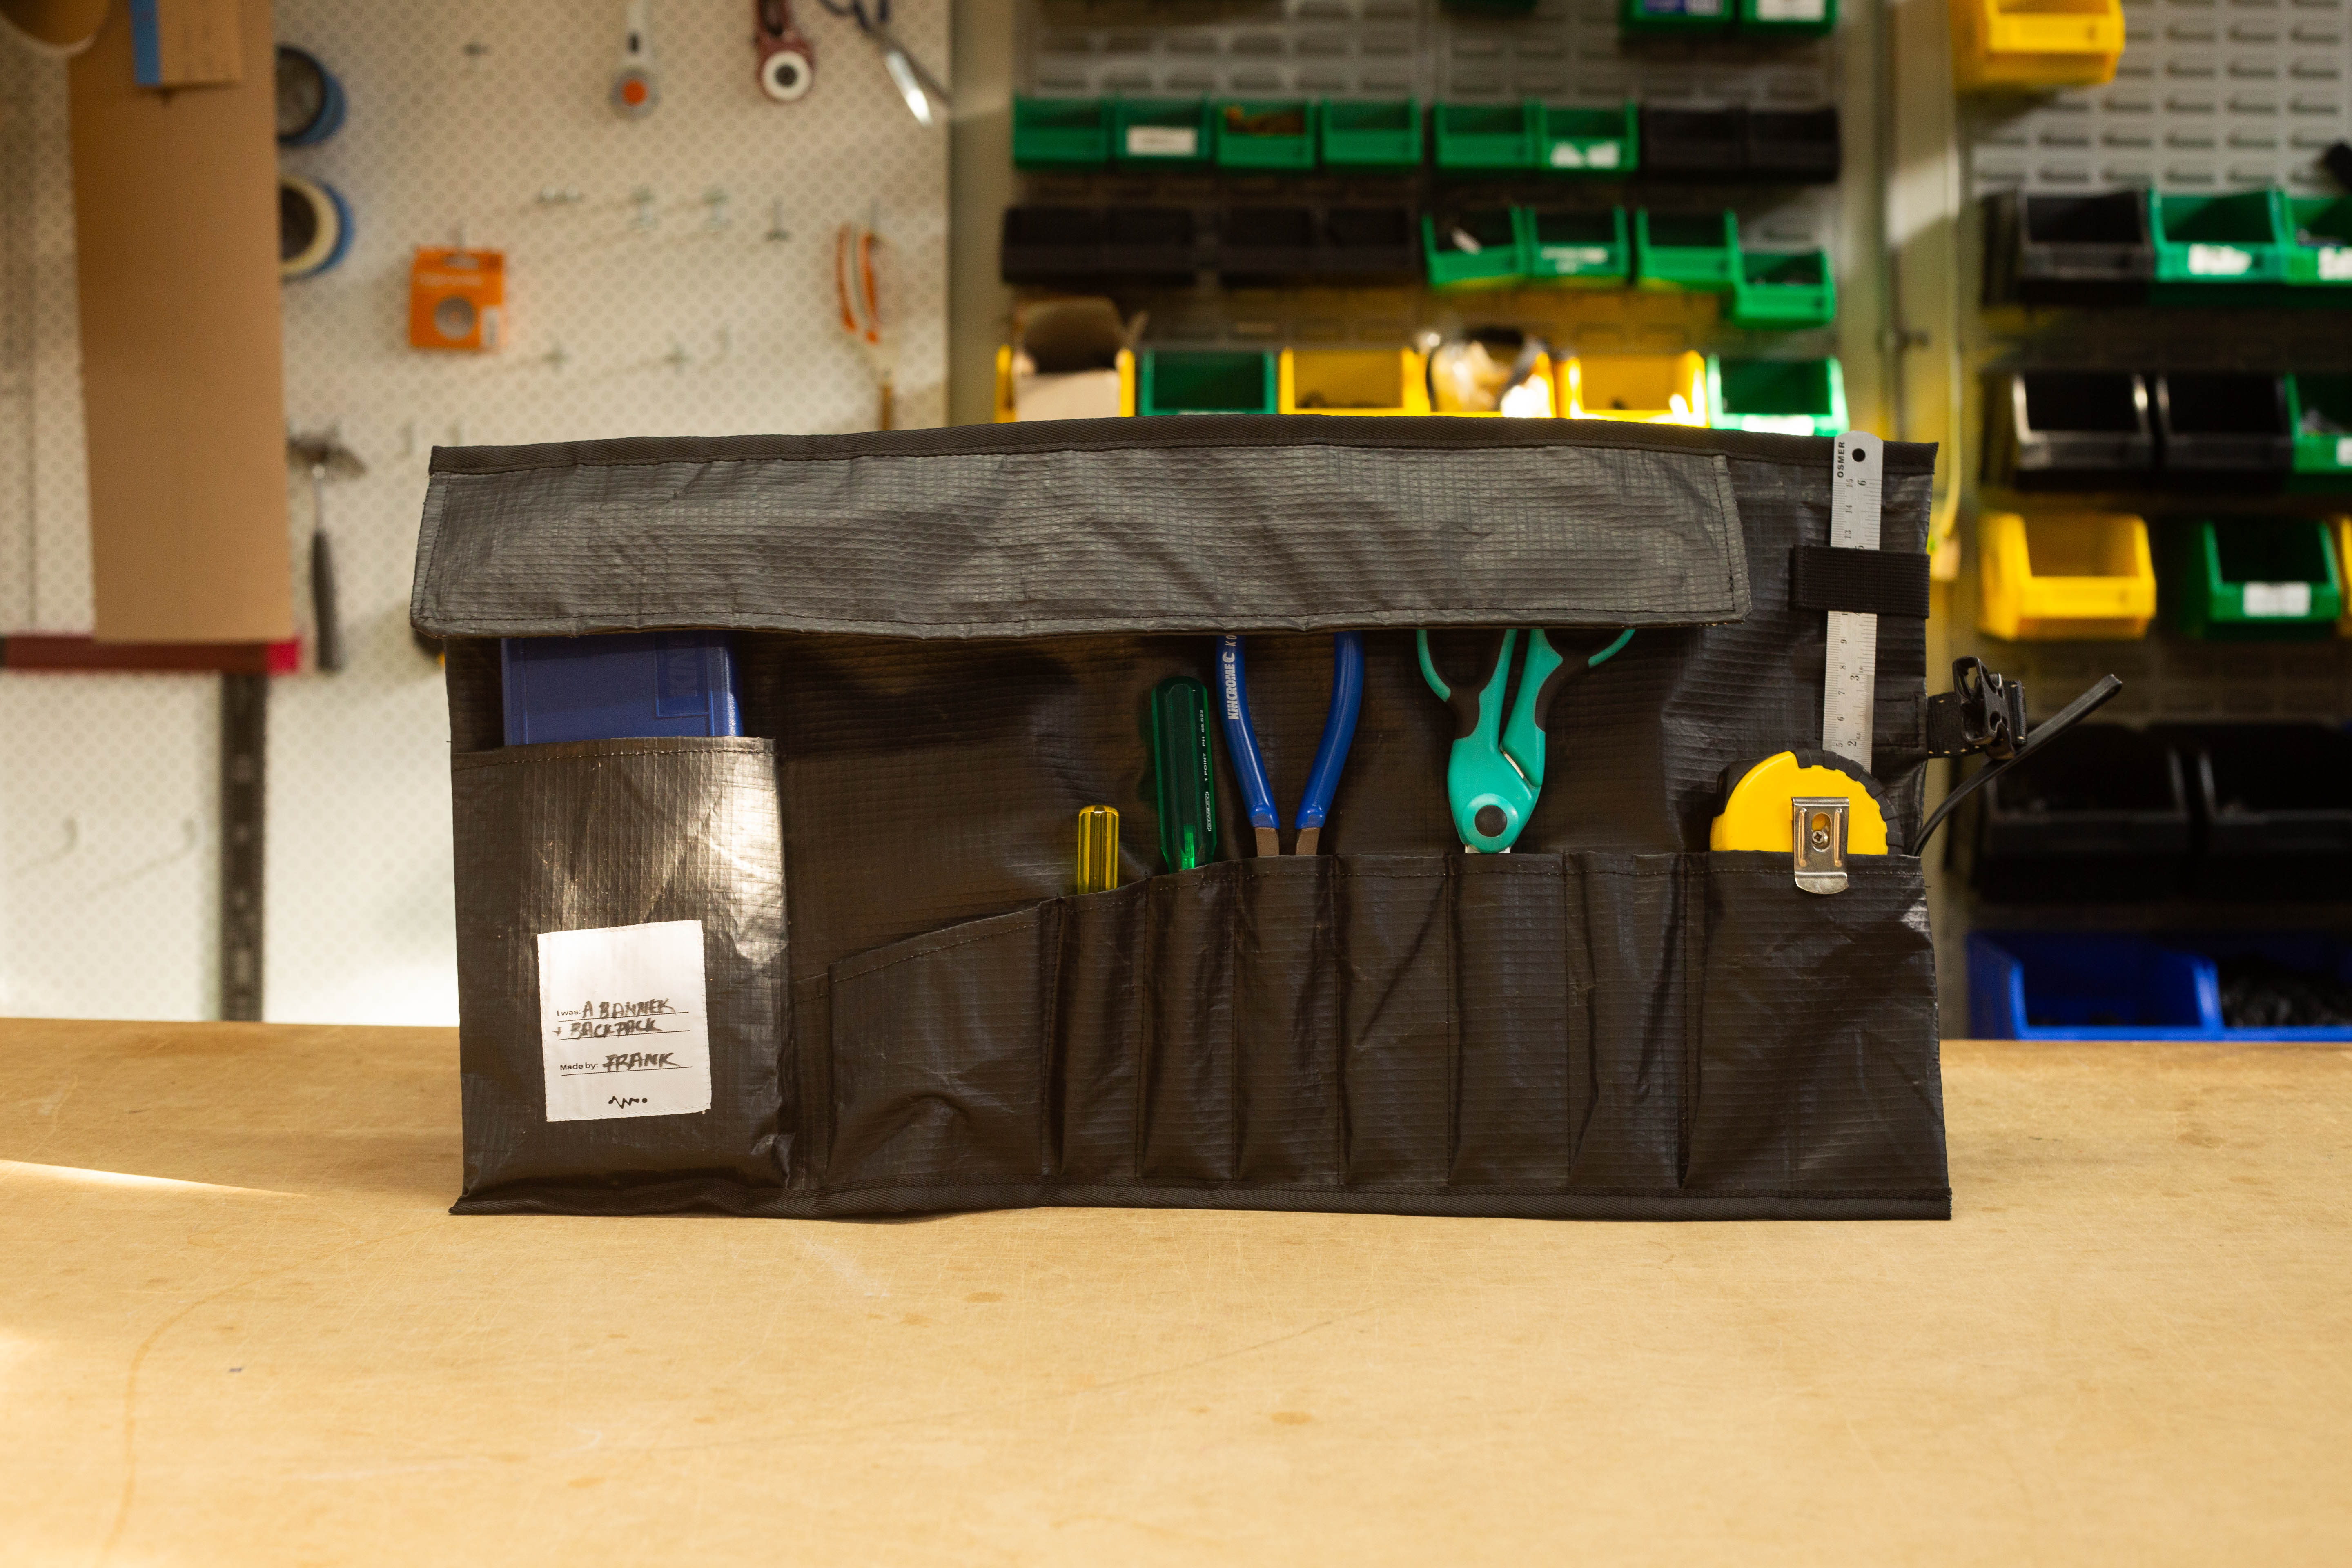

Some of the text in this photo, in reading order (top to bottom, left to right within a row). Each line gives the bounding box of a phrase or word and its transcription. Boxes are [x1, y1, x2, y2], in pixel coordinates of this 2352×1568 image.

[1837, 441, 1845, 478] OSMER
[1844, 478, 1853, 539] 13 14 15
[1224, 664, 1240, 720] KINCROME
[1202, 736, 1206, 746] PH
[582, 1000, 593, 1018] A
[570, 1017, 663, 1040] BACKPACK
[585, 1062, 598, 1070] by:
[601, 1052, 681, 1073] FRANK
